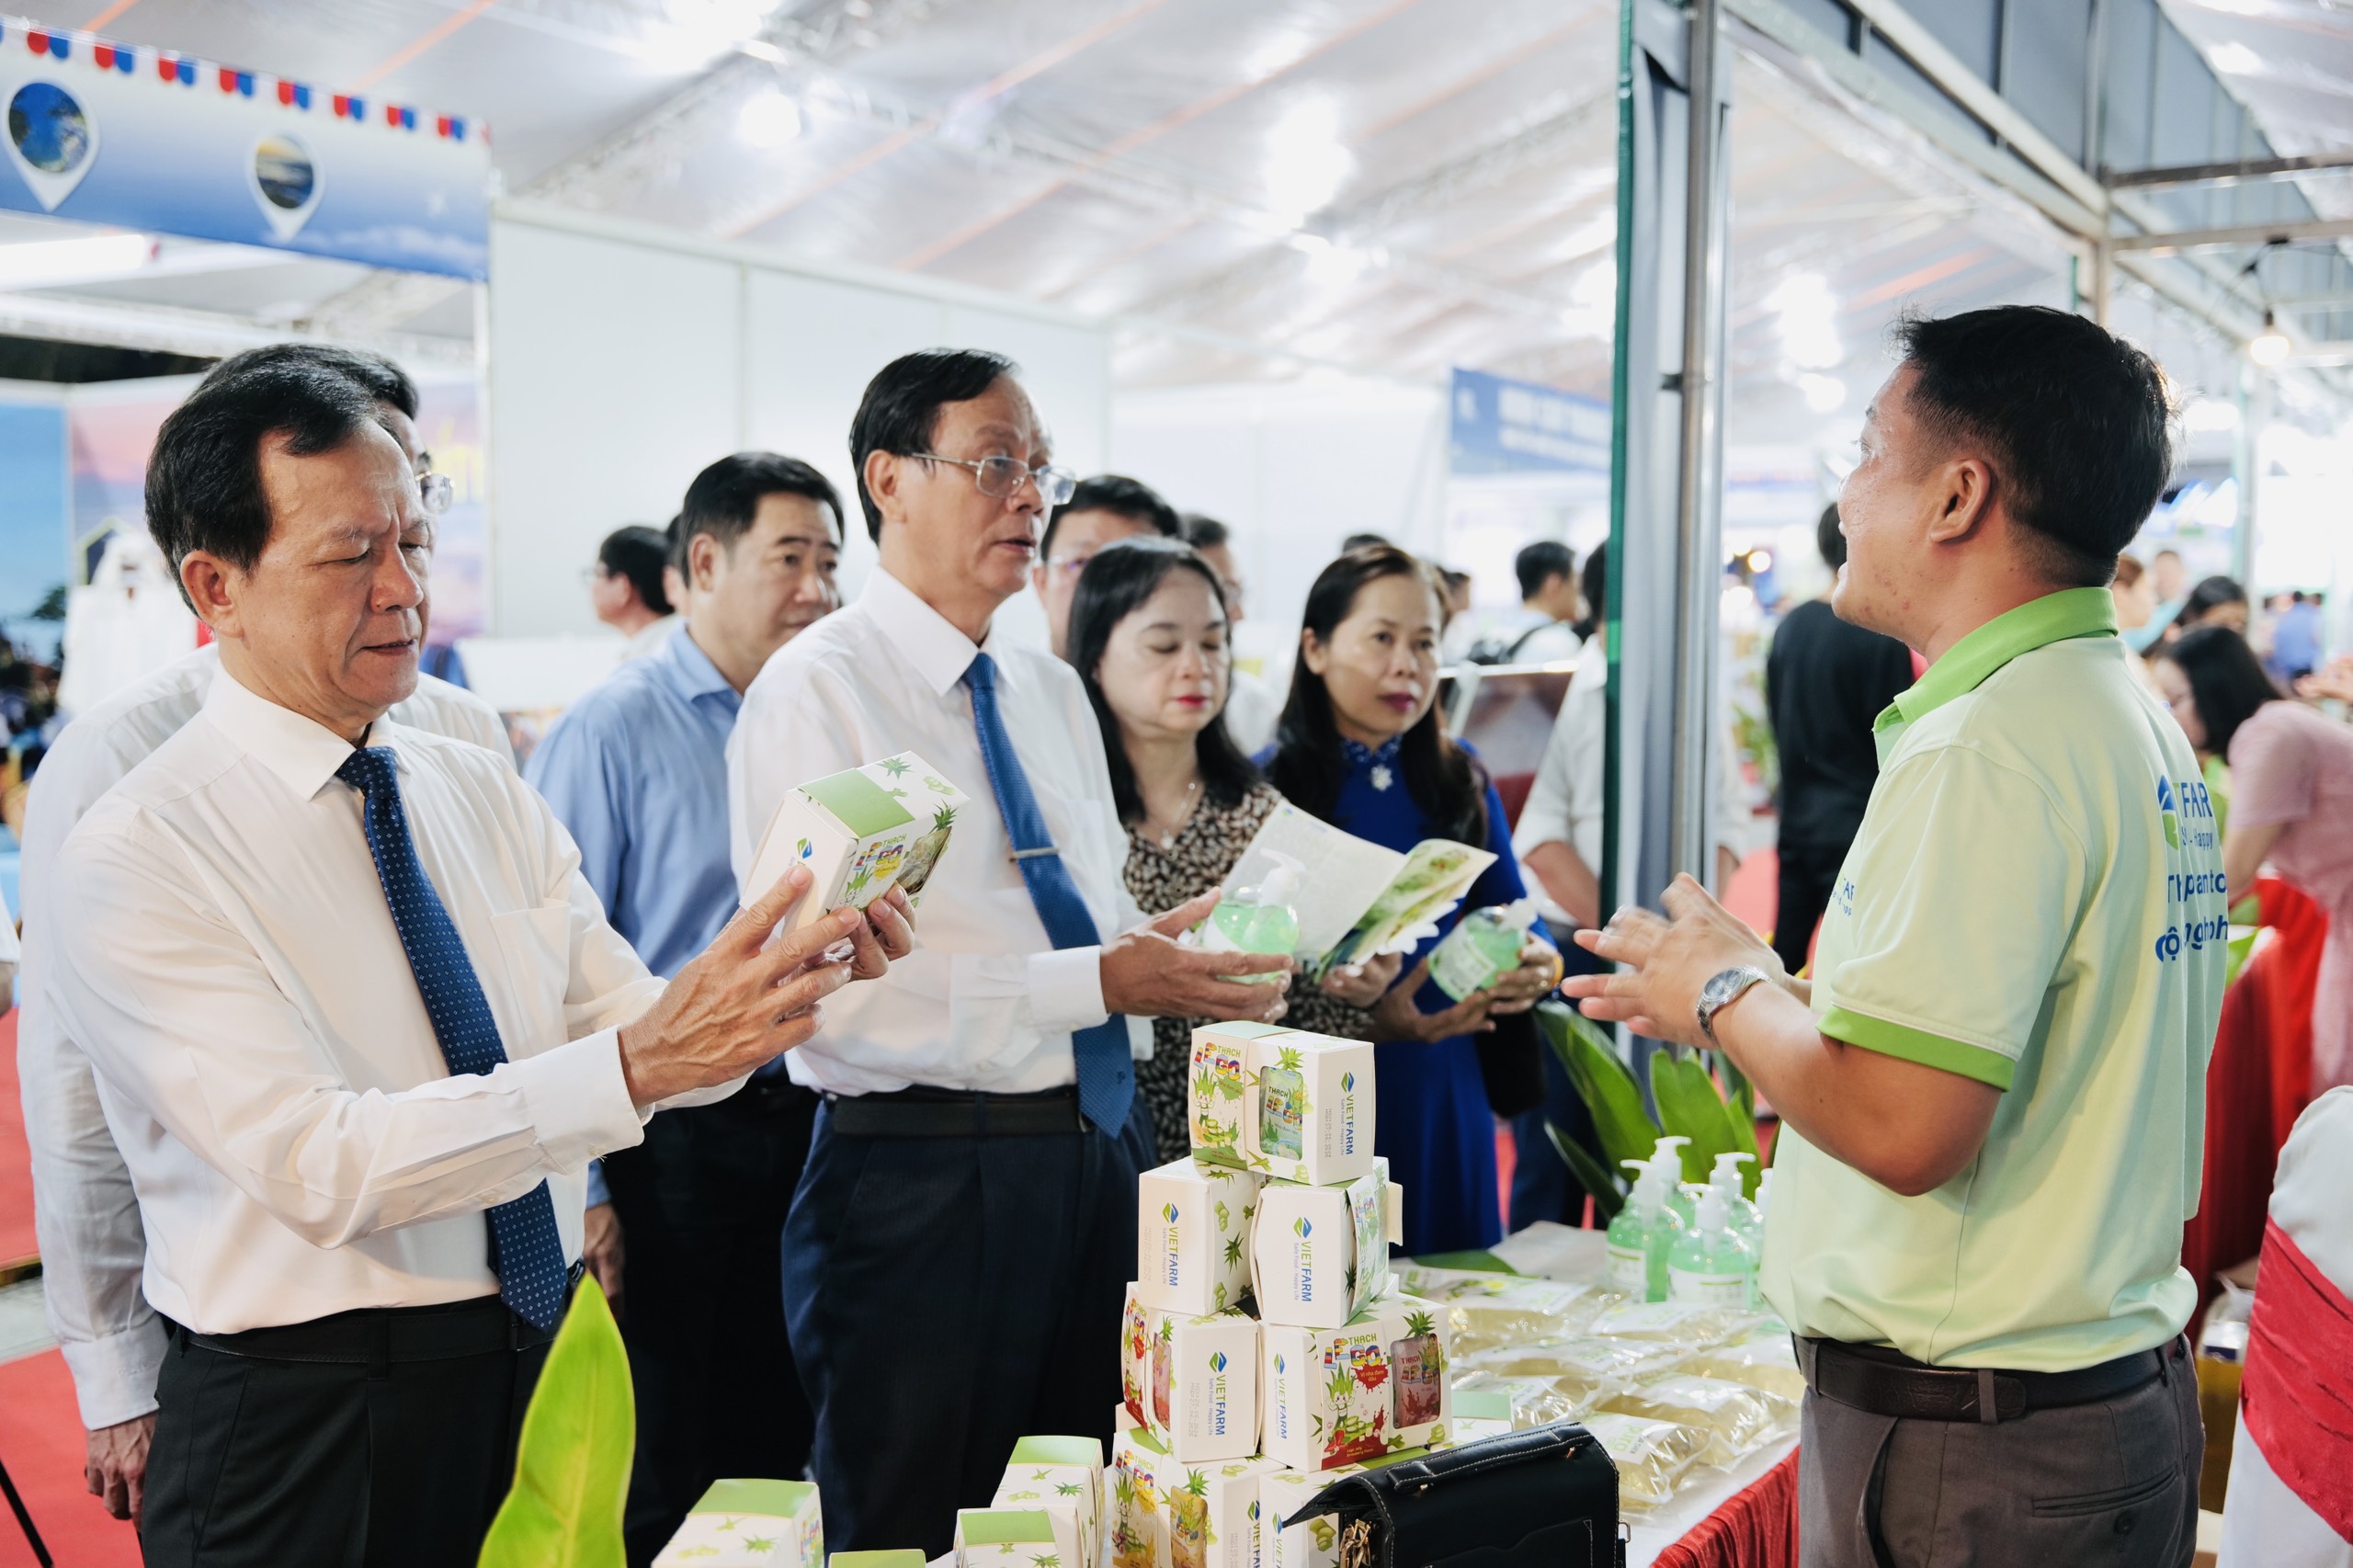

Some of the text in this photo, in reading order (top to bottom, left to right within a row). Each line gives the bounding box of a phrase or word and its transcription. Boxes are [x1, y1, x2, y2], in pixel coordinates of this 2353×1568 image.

[1193, 1041, 1241, 1082] LEGO
[1346, 1094, 1354, 1154] VIETFARM
[1168, 1226, 1178, 1287] VIETFARM
[1301, 1241, 1312, 1302] VIETFARM
[1324, 1337, 1382, 1369] LEGO
[1215, 1374, 1226, 1436] VIETFARM
[1279, 1378, 1287, 1439] VIETFARM
[1115, 1449, 1154, 1494] LEGO
